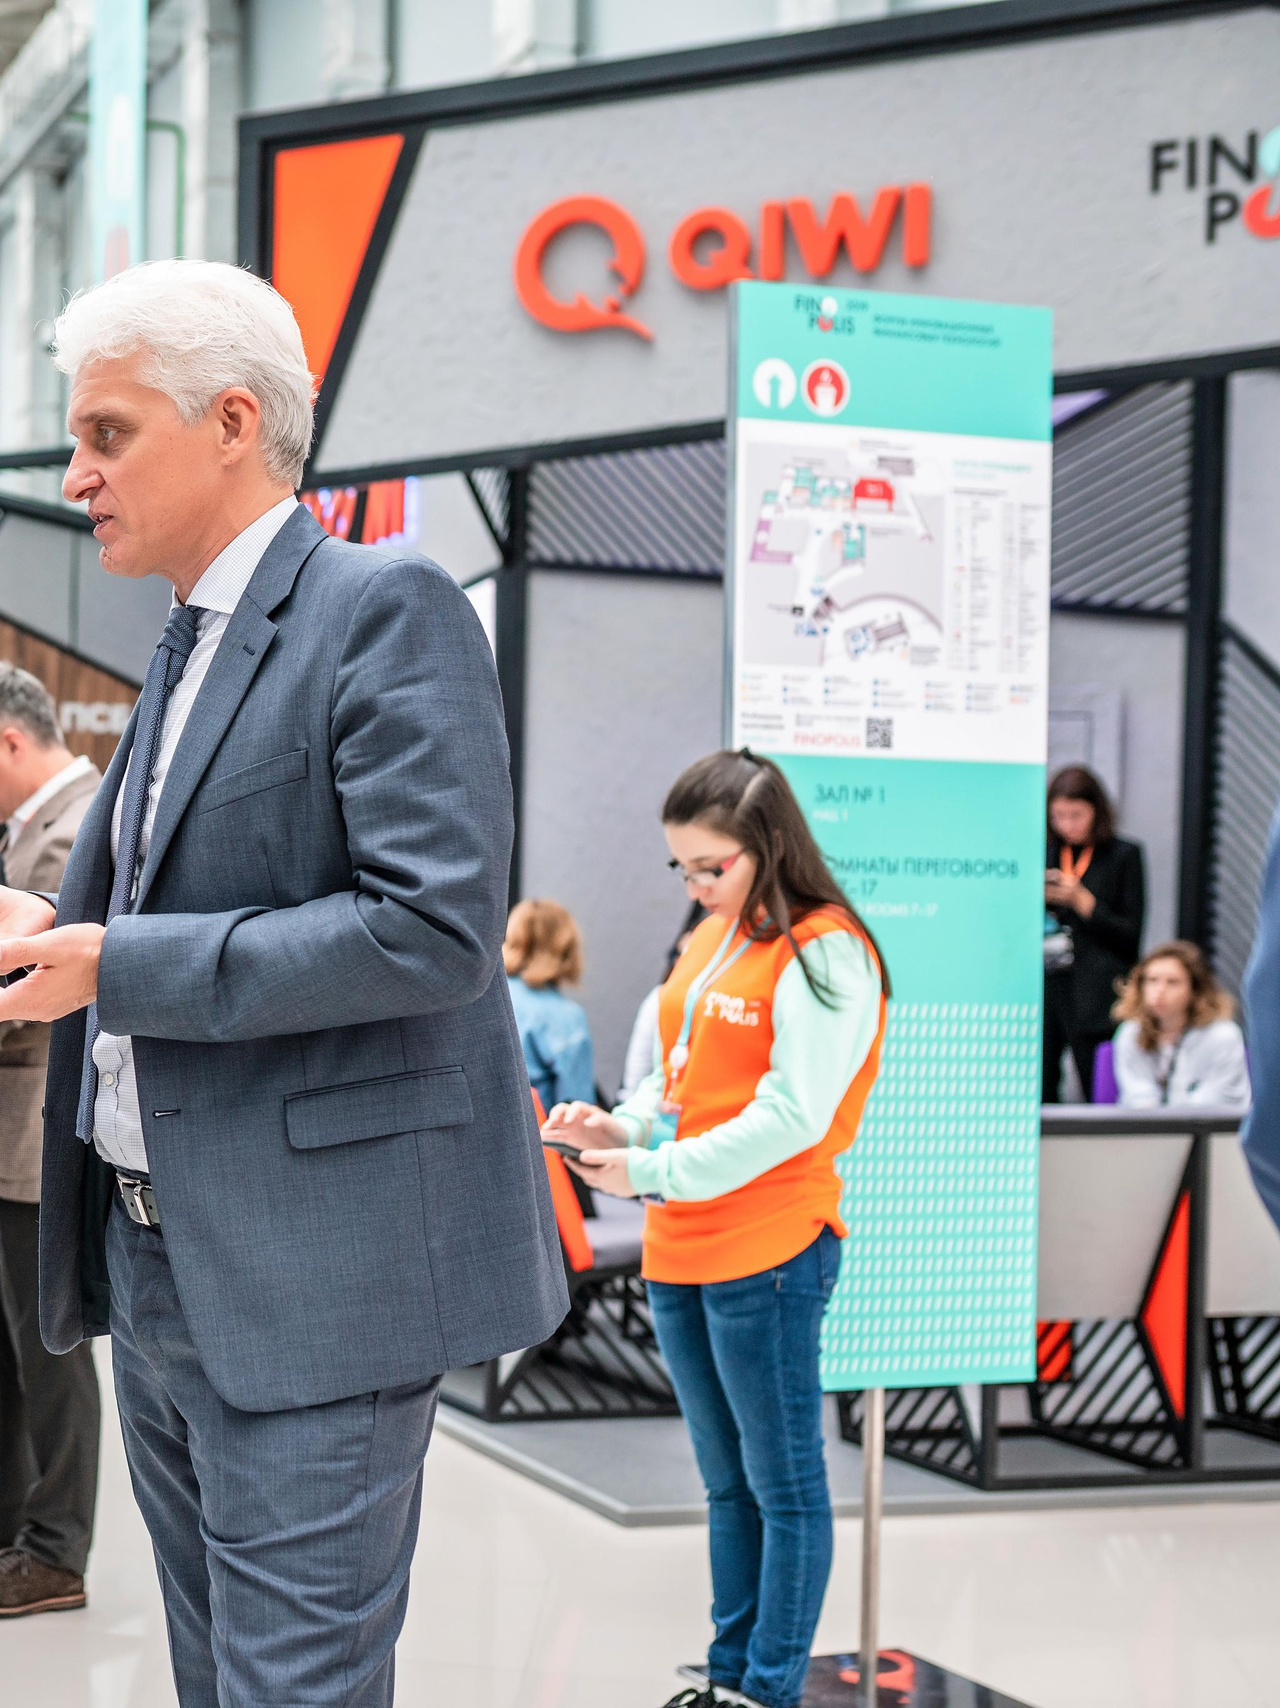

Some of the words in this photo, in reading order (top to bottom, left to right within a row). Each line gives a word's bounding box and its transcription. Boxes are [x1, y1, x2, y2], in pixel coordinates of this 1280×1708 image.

[667, 183, 933, 290] QIWI
[816, 784, 849, 805] ЗАЛ
[904, 857, 1020, 880] ПЕРЕГОВОРОВ
